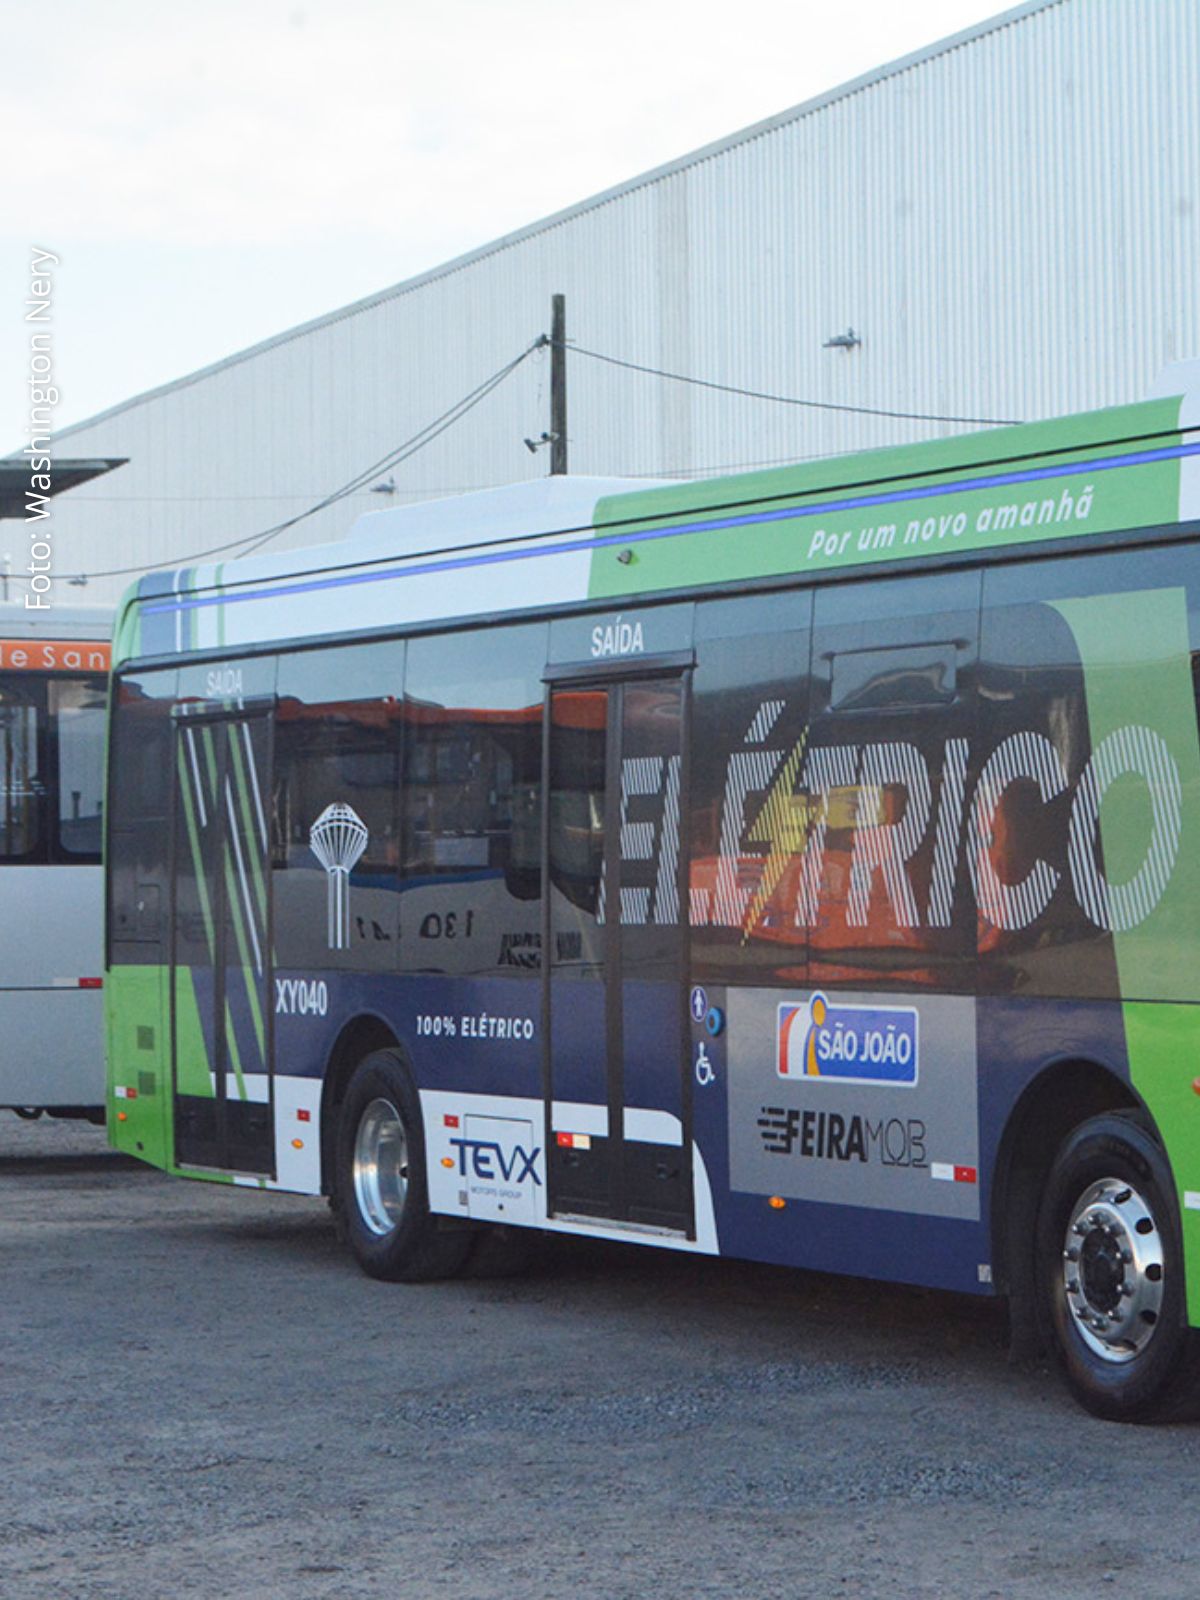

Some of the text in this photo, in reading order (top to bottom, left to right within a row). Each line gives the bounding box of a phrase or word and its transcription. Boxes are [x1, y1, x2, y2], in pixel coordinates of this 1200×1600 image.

[808, 486, 1095, 559] Por um novo amanhã
[591, 617, 644, 656] SAÍDA
[0, 646, 28, 668] e
[206, 663, 244, 696] SAÍDA
[596, 700, 1182, 932] ELÉTRICO
[275, 979, 328, 1015] XY040
[416, 1010, 535, 1040] 100% ELÉTRICO
[818, 1022, 911, 1064] SÃO JOÃO
[449, 1138, 542, 1186] TEVX
